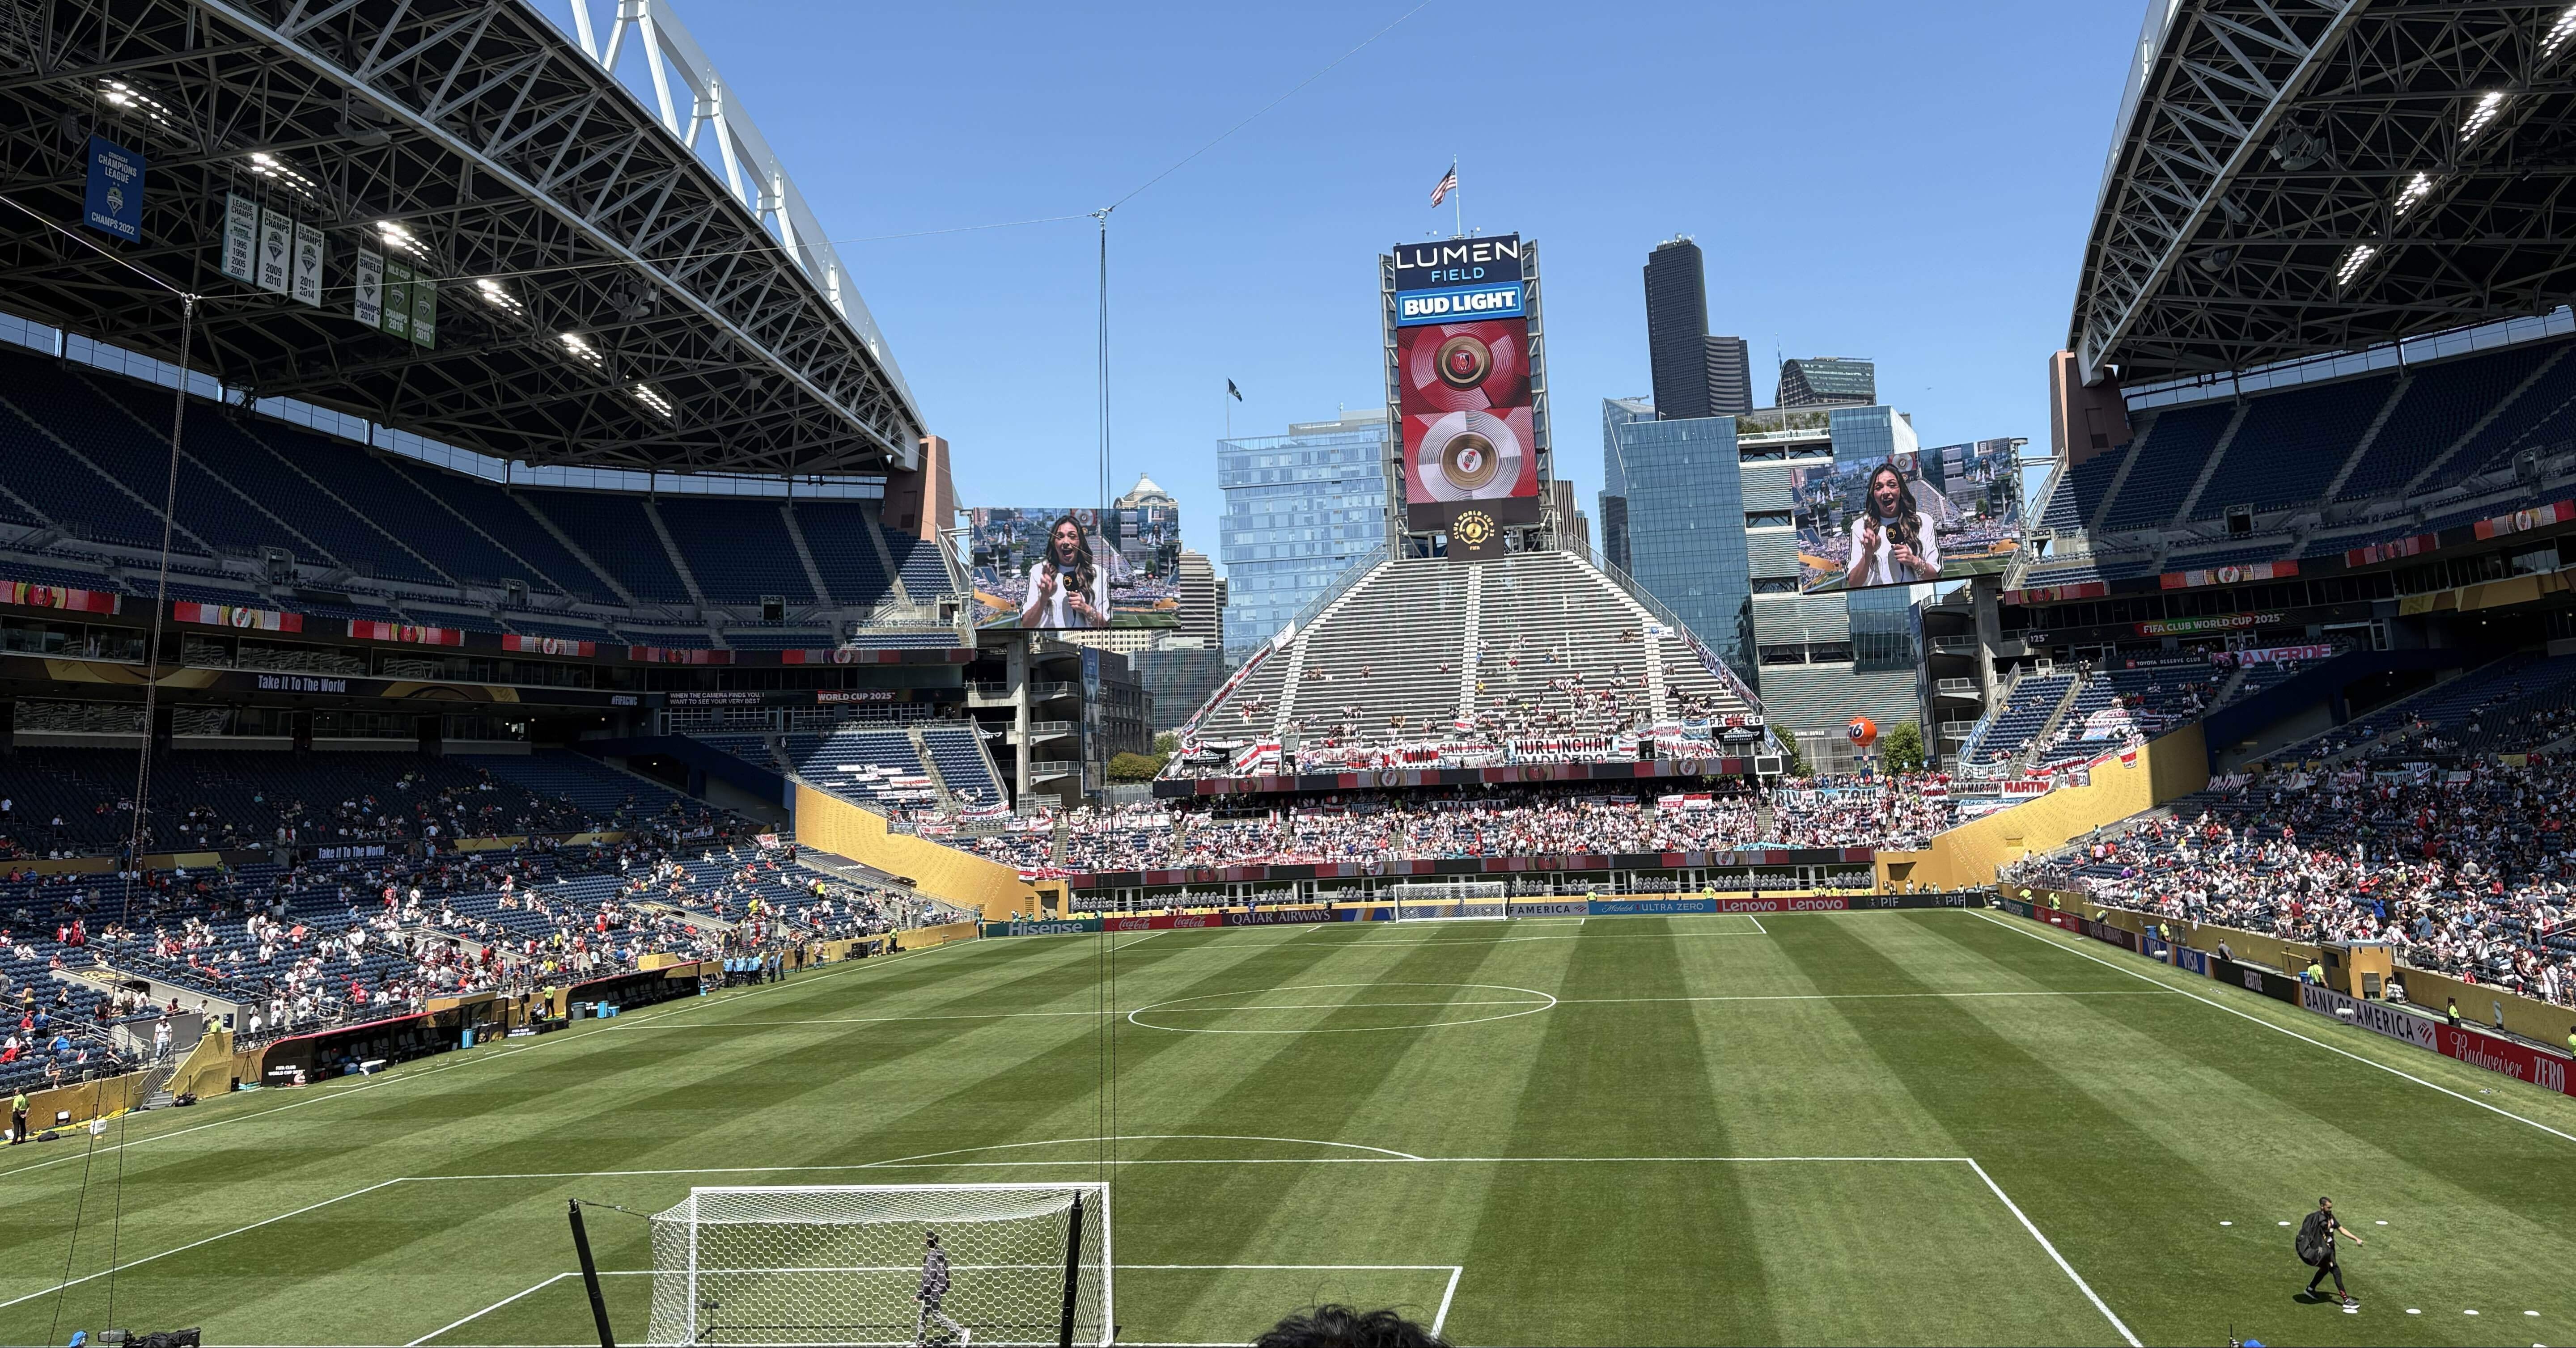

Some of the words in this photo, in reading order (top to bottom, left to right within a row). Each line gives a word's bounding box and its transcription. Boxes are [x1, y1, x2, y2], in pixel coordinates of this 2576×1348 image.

[98, 154, 137, 177] CHAMPIONS
[105, 166, 129, 184] LEAGUE
[233, 199, 253, 212] LEAGUE
[231, 206, 254, 220] CHAMPS
[91, 211, 118, 229] CHAMPS
[119, 222, 134, 235] 2022
[264, 218, 289, 234] CHAMPS
[233, 238, 247, 249] 1995
[298, 231, 322, 247] CHAMPS
[233, 247, 246, 259] 1996
[1396, 240, 1518, 269] LUMEN
[232, 256, 246, 268] 2005
[359, 258, 381, 274] SHIELD
[230, 266, 245, 277] 2007
[266, 263, 282, 276] 2009
[388, 264, 398, 276] MLS
[400, 269, 410, 280] CUP
[1431, 267, 1485, 283] FIELD
[265, 274, 281, 287] 2010
[300, 276, 314, 289] 2011
[426, 280, 436, 291] CUP
[300, 286, 314, 299] 2014
[356, 300, 380, 315] CHAMPS
[1404, 296, 1450, 316] BUD
[360, 311, 374, 322] 2014
[386, 308, 407, 324] CHAMPS
[413, 318, 434, 334] CHAMPS
[1457, 510, 1482, 521] WORLD
[1483, 514, 1494, 526] CUP
[2144, 624, 2165, 634] FIFA
[2167, 621, 2191, 632] CLUB
[2193, 619, 2229, 630] WORLD
[2232, 616, 2252, 626] CUP
[2257, 646, 2330, 663] VERDE
[258, 675, 280, 689] Take
[281, 676, 288, 689] It
[291, 677, 301, 690] To
[303, 678, 318, 691] The
[321, 679, 346, 693] World
[611, 695, 637, 706] #FIFACWC
[818, 693, 849, 701] WORLD
[851, 693, 868, 701] CUP
[1709, 716, 1760, 727] PACHECO
[1440, 743, 1463, 754] SAN
[1514, 736, 1614, 755] HURLINGHAM
[1657, 740, 1673, 752] SAN
[1677, 743, 1714, 756] MIGUEL
[1348, 751, 1356, 759] DE
[1358, 750, 1377, 759] MAYO
[1405, 749, 1433, 764] LIMA
[1978, 764, 2005, 777] CUARTO
[2060, 774, 2088, 785] PACHECO
[1968, 783, 1999, 793] MARTIN
[2004, 781, 2050, 793] MARTIN
[318, 847, 335, 859] Take
[336, 847, 343, 858] It
[343, 846, 352, 858] To
[352, 846, 365, 857] The
[366, 845, 385, 857] World
[1379, 851, 1403, 861] VILLA
[1403, 849, 1414, 860] DE
[1415, 849, 1439, 860] MAYO
[1722, 899, 1777, 912] Lenovo
[1788, 897, 1843, 910] Lenovo
[1880, 897, 1899, 907] PIF
[1946, 895, 1964, 905] PIF
[1517, 905, 1570, 914] AMERICA
[1602, 903, 1634, 913] Michelob
[1641, 903, 1674, 911] ULTRA
[1676, 902, 1704, 911] ZERO
[1232, 912, 1273, 925] QATAR
[1278, 909, 1331, 922] AIRWAYS
[1008, 922, 1084, 936] Hisense
[2181, 949, 2199, 973] VISA
[2244, 969, 2263, 992] SEATTLE
[2304, 987, 2337, 1012] BANK
[2356, 1004, 2415, 1041] AMERICA
[2449, 1031, 2522, 1079] Budweiser
[2533, 1056, 2565, 1093] ZERO
